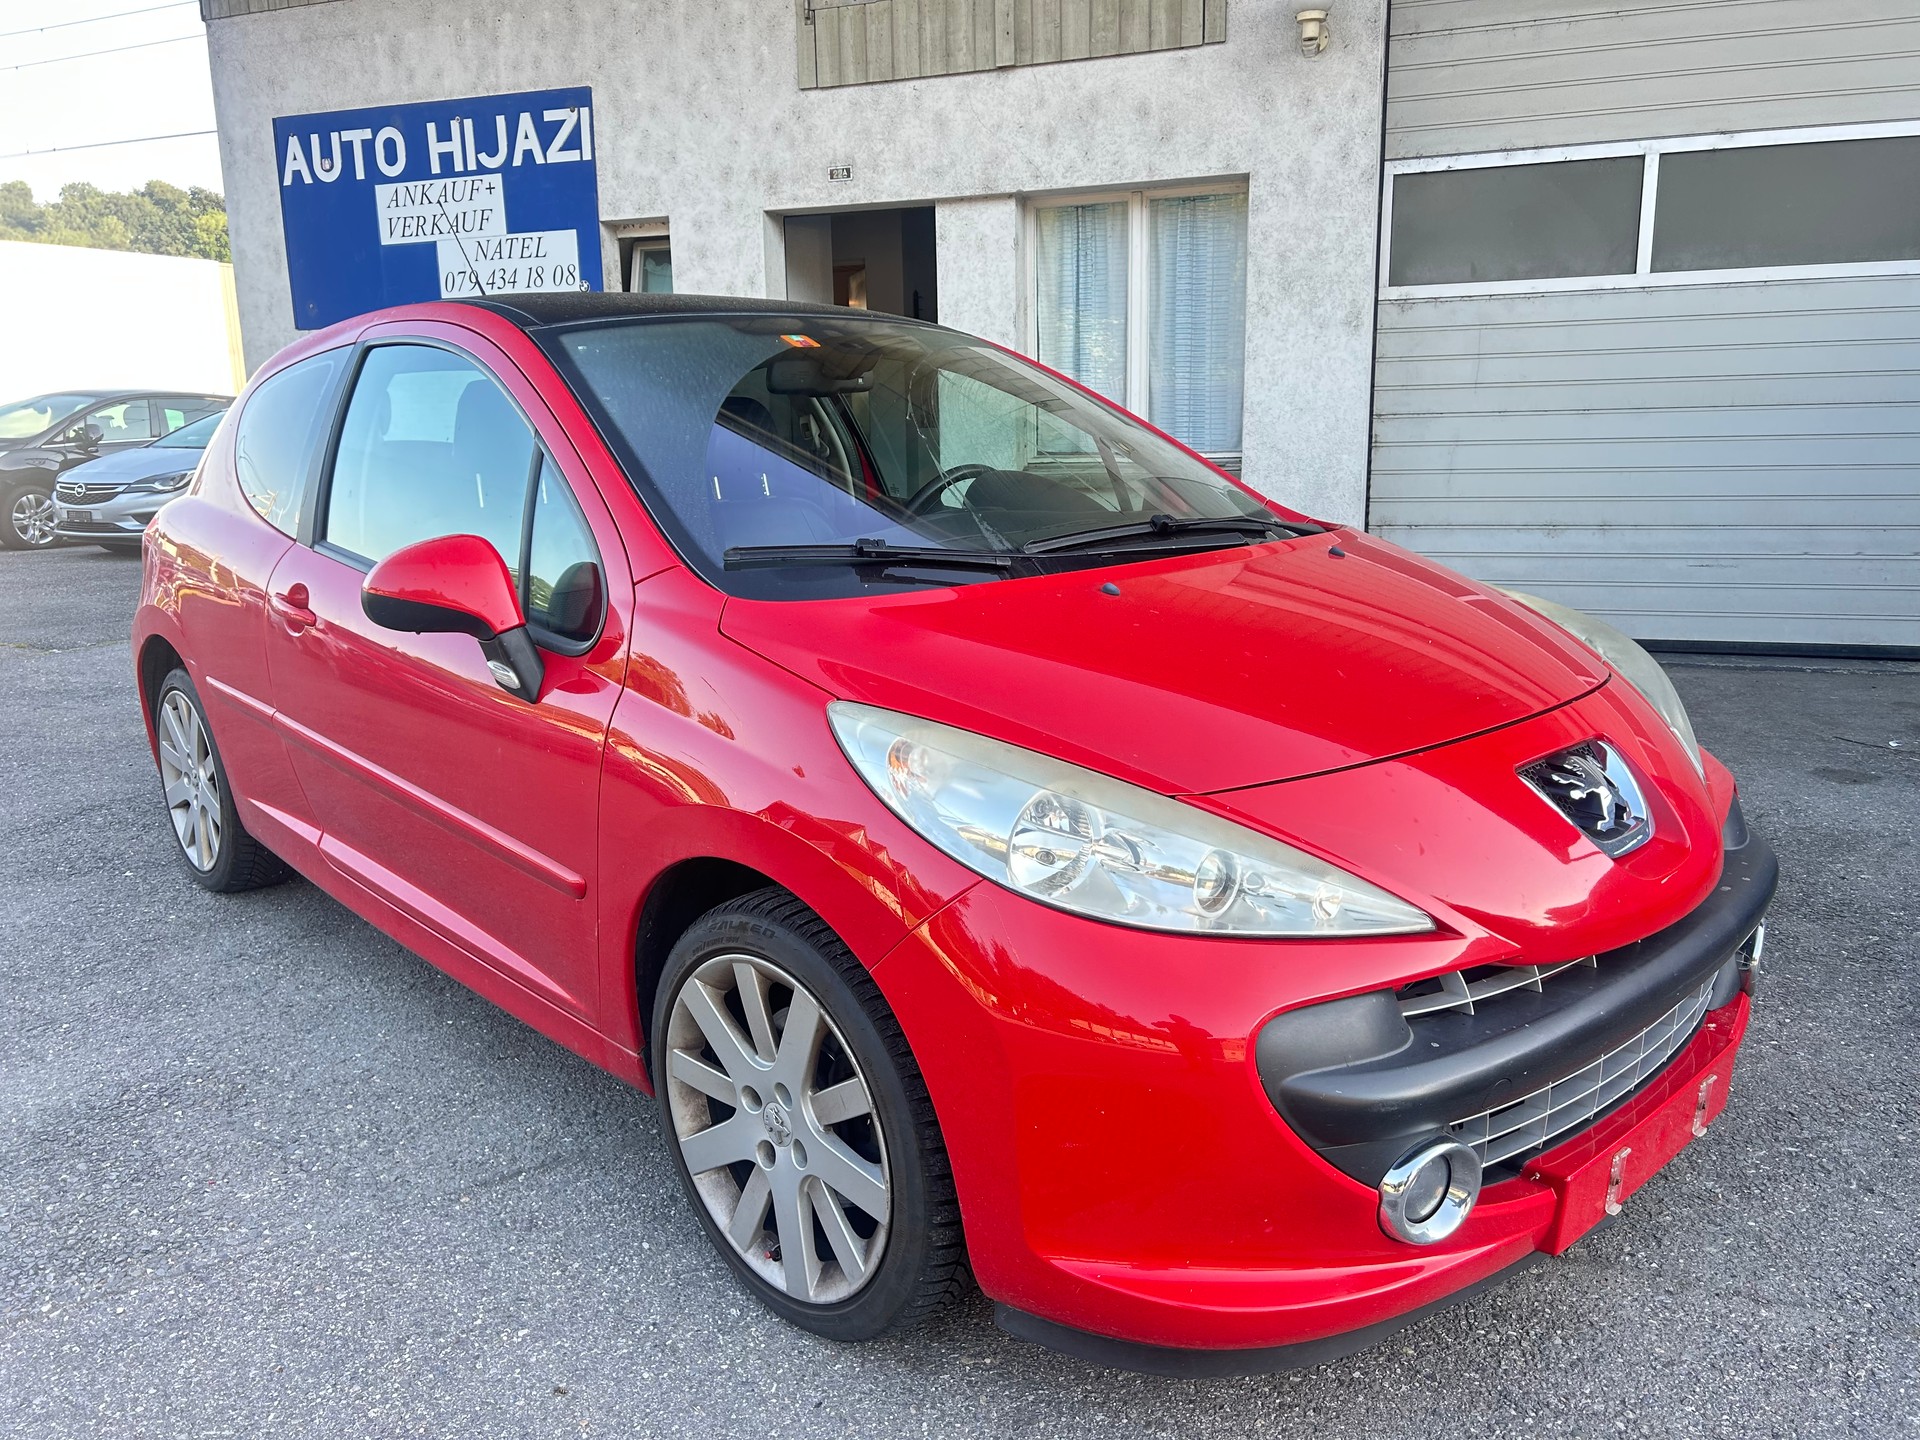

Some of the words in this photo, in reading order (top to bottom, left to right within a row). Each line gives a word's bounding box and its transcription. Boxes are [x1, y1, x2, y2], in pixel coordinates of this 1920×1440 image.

[283, 126, 407, 186] AUTO
[426, 107, 592, 174] HIJAZI
[387, 179, 496, 208] ANKAUF+
[387, 209, 493, 239] VERKAUF
[475, 236, 548, 262] NATEL
[445, 270, 479, 293] 079
[486, 268, 518, 290] 434
[525, 266, 545, 288] 18
[553, 264, 576, 287] 08
